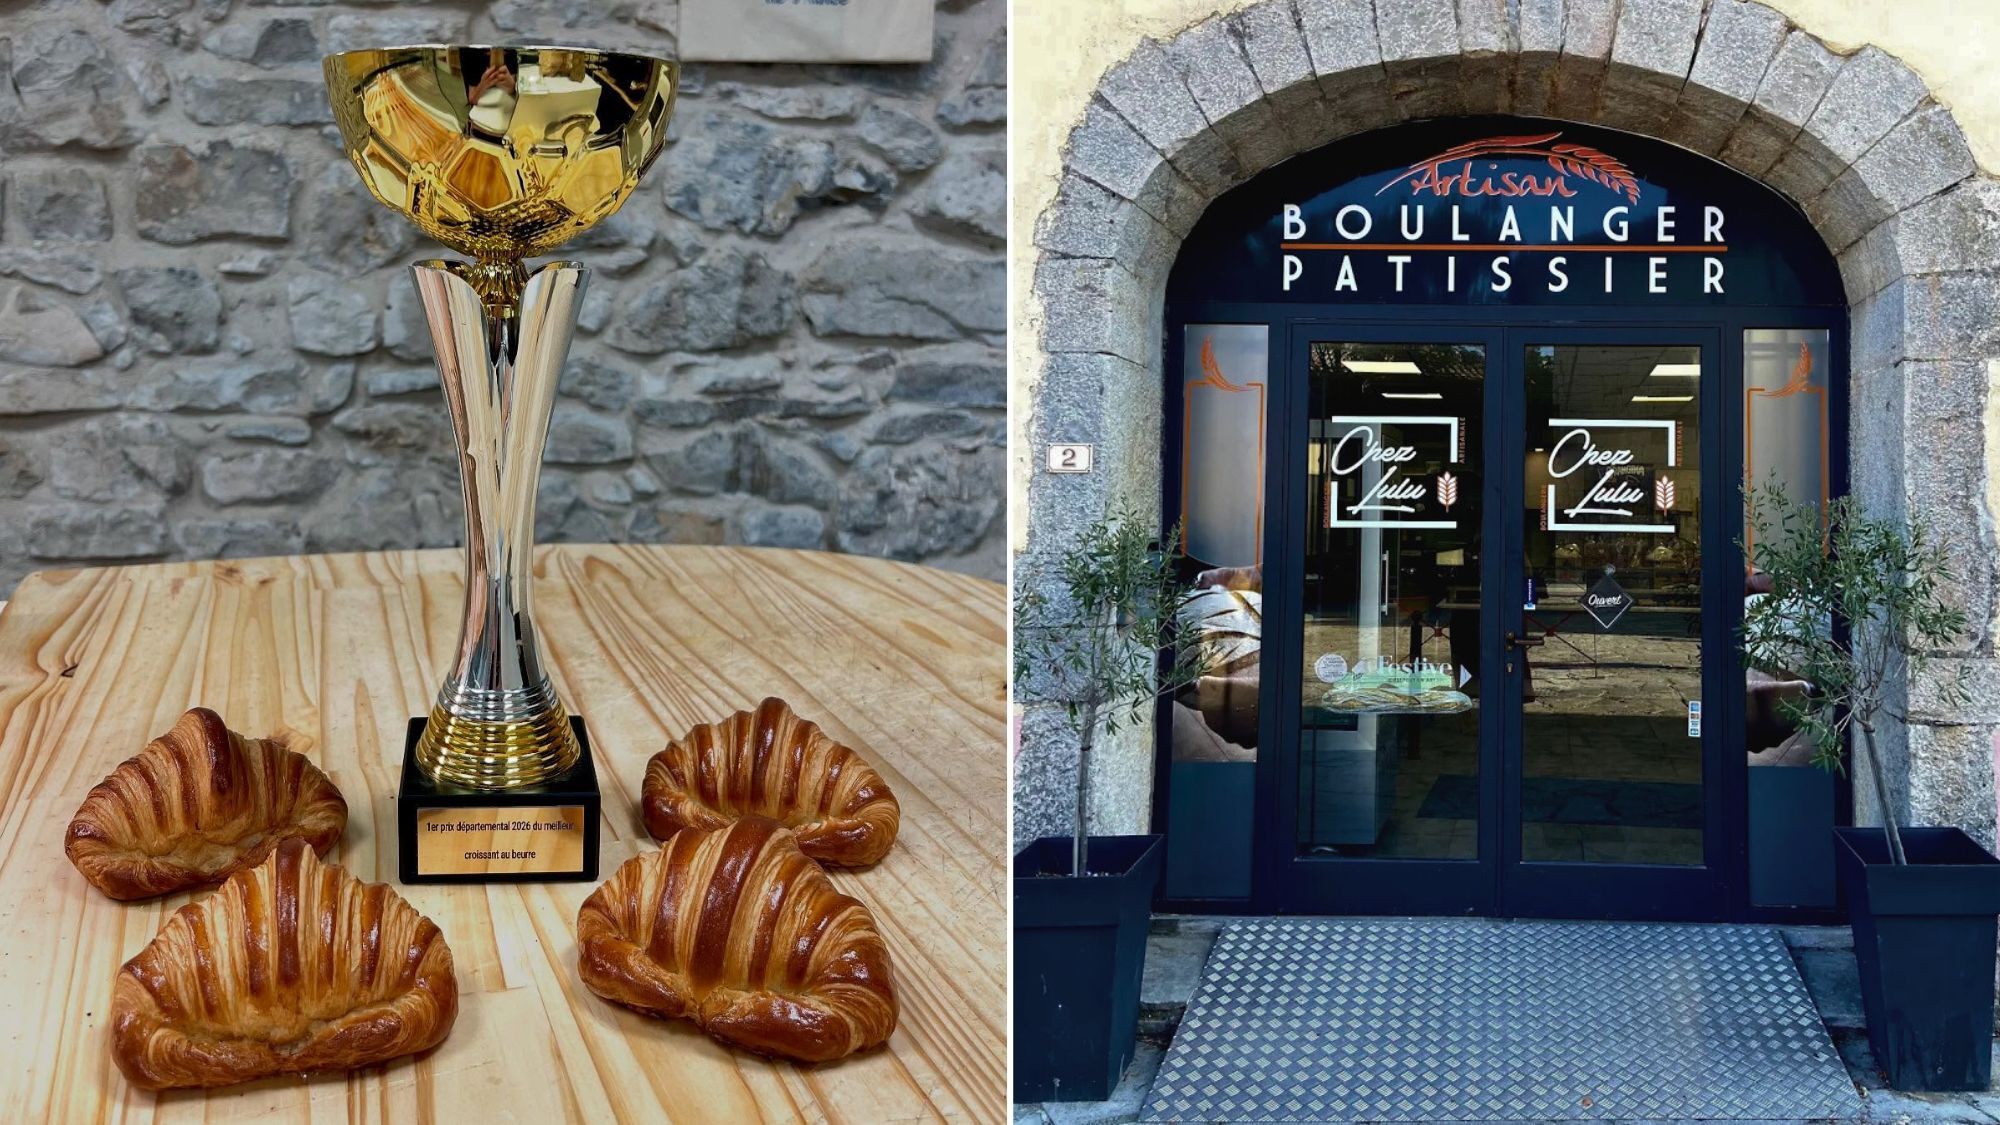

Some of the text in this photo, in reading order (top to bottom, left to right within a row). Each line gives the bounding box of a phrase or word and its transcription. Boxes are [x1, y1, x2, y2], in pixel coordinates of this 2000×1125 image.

[1411, 160, 1578, 198] Artisan
[1283, 204, 1725, 242] BOULANGER
[1283, 255, 1725, 293] PATISSIER
[1062, 448, 1076, 467] 2
[1331, 426, 1417, 475] Chez
[1548, 428, 1634, 478] Chez
[1346, 465, 1427, 515] Lulu
[1563, 469, 1645, 518] Lulu
[427, 821, 575, 833] 1er prix départemental 2026 du meilleur
[464, 849, 536, 860] croissant au beurre
